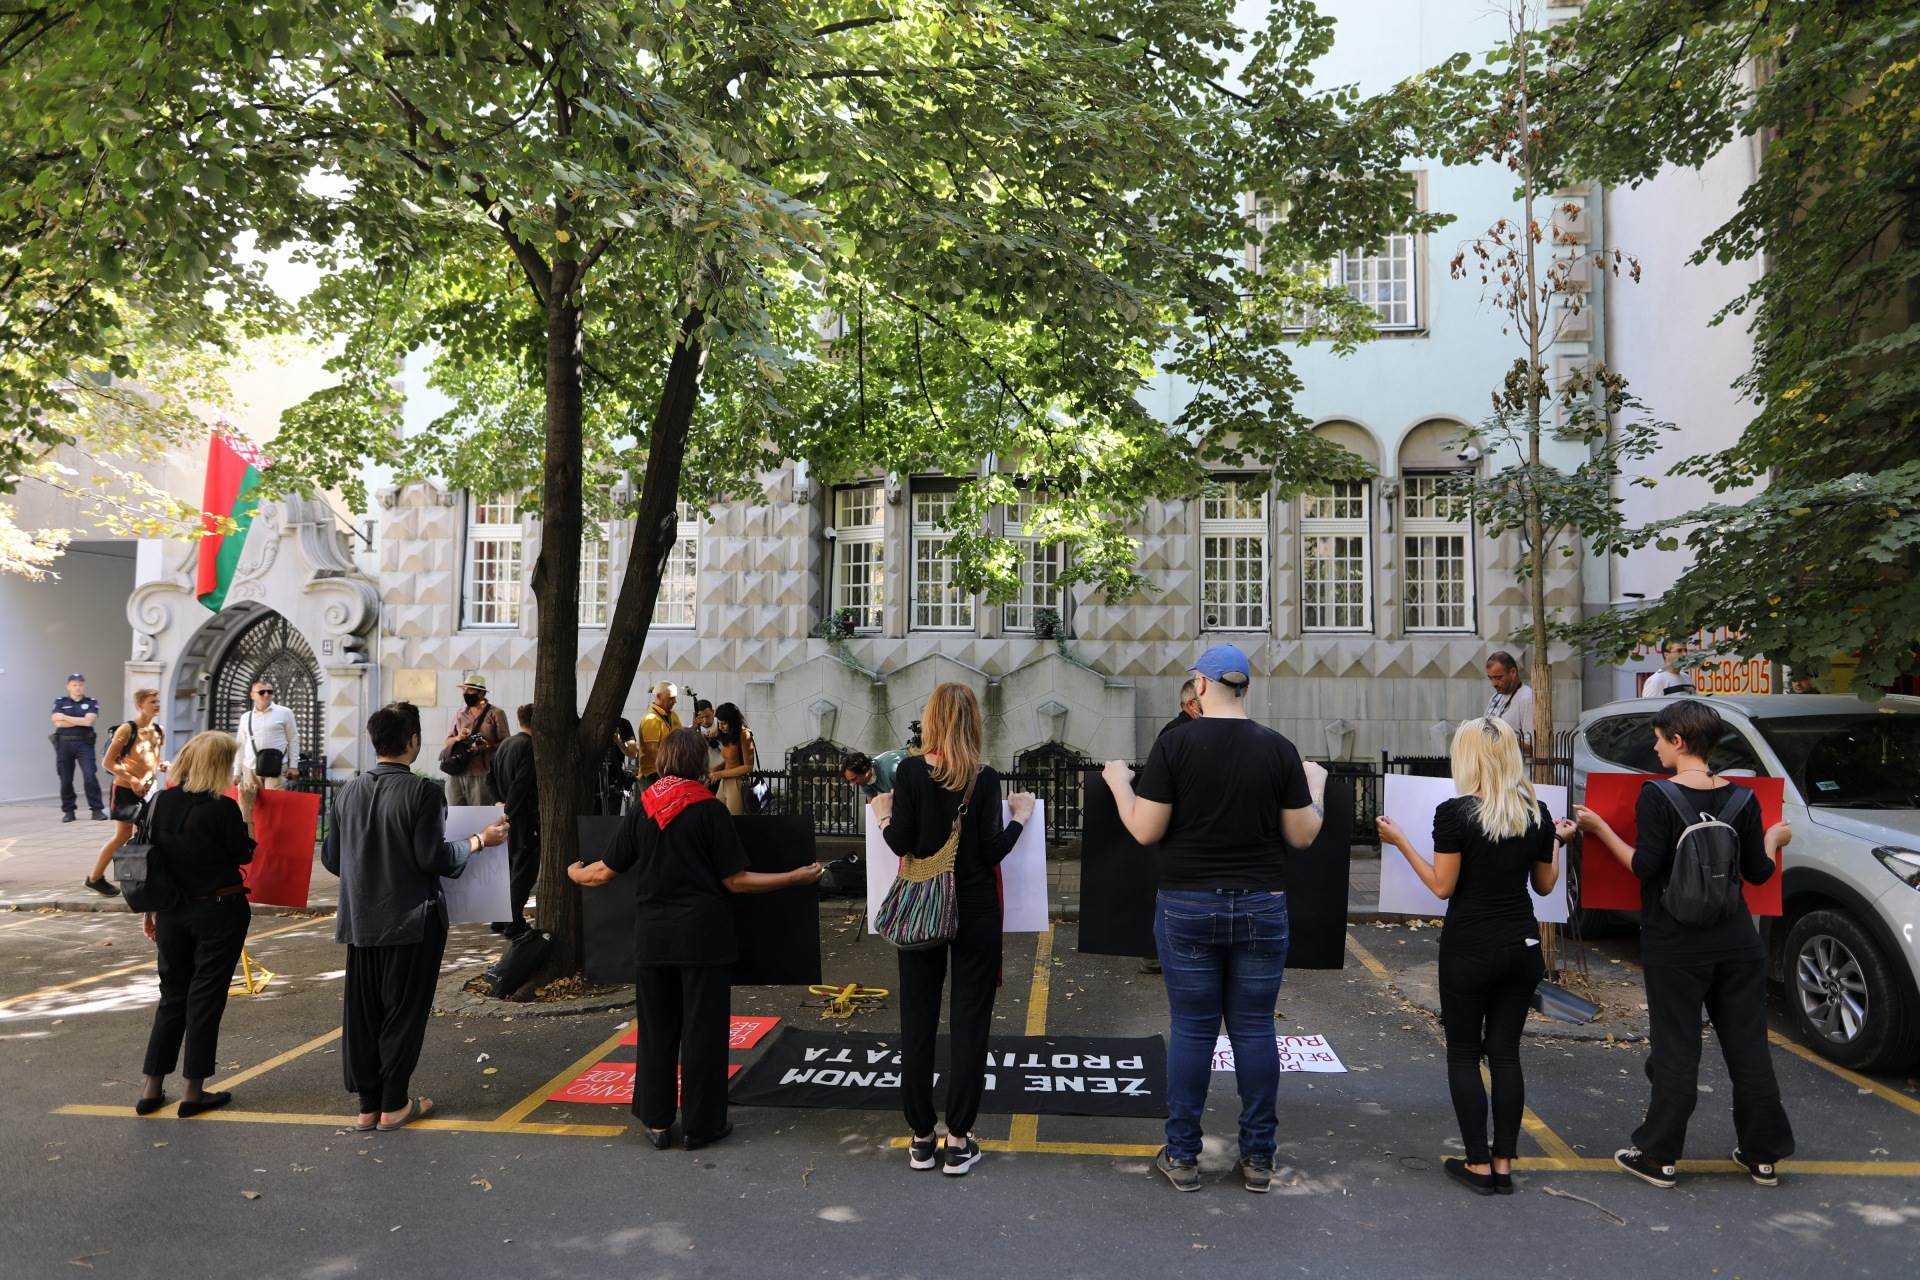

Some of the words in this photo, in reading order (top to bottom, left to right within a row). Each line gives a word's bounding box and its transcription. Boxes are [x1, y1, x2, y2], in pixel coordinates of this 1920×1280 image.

[780, 1069, 940, 1087] RNOM
[1025, 1075, 1151, 1095] ŽENE
[566, 1083, 635, 1100] ENKO
